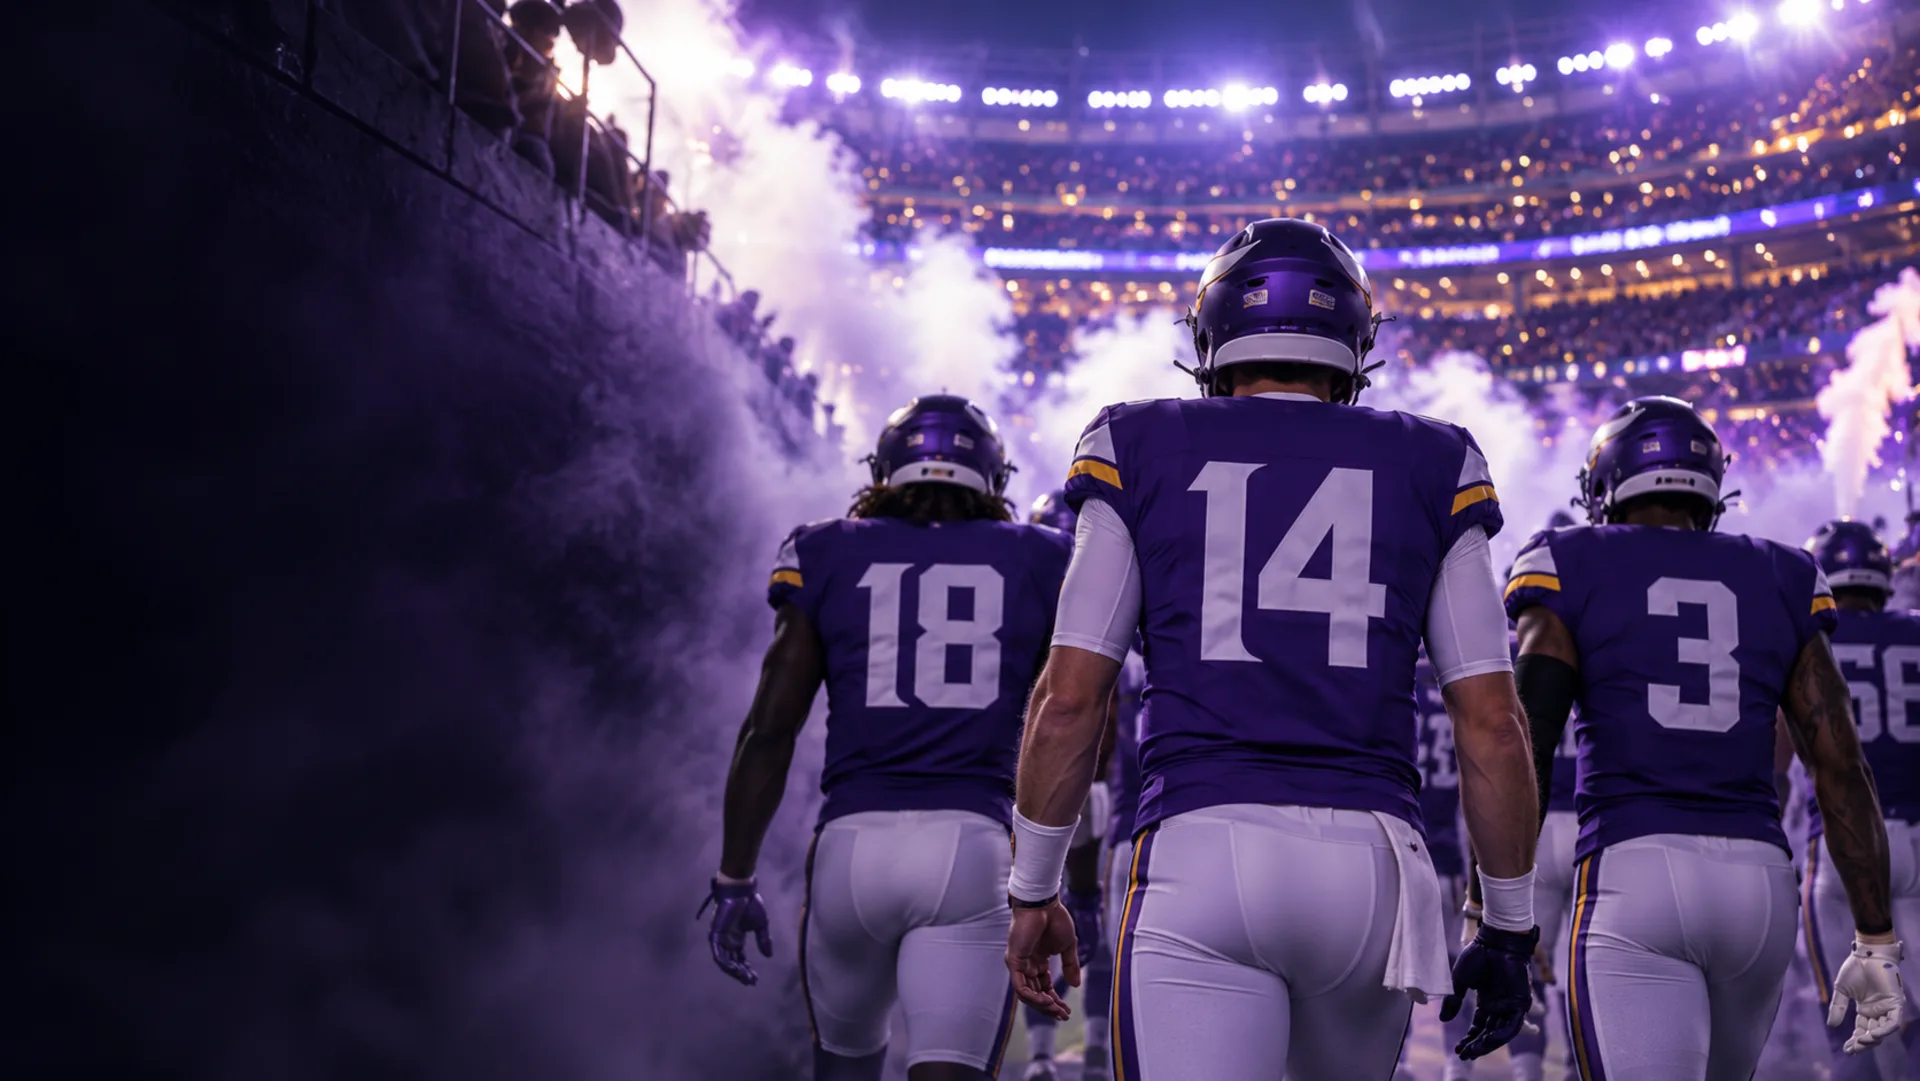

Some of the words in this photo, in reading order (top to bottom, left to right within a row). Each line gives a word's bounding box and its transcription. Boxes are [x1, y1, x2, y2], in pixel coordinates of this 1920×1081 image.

[856, 563, 1004, 709] 18
[1187, 461, 1387, 668] 14
[1647, 576, 1740, 732] 3
